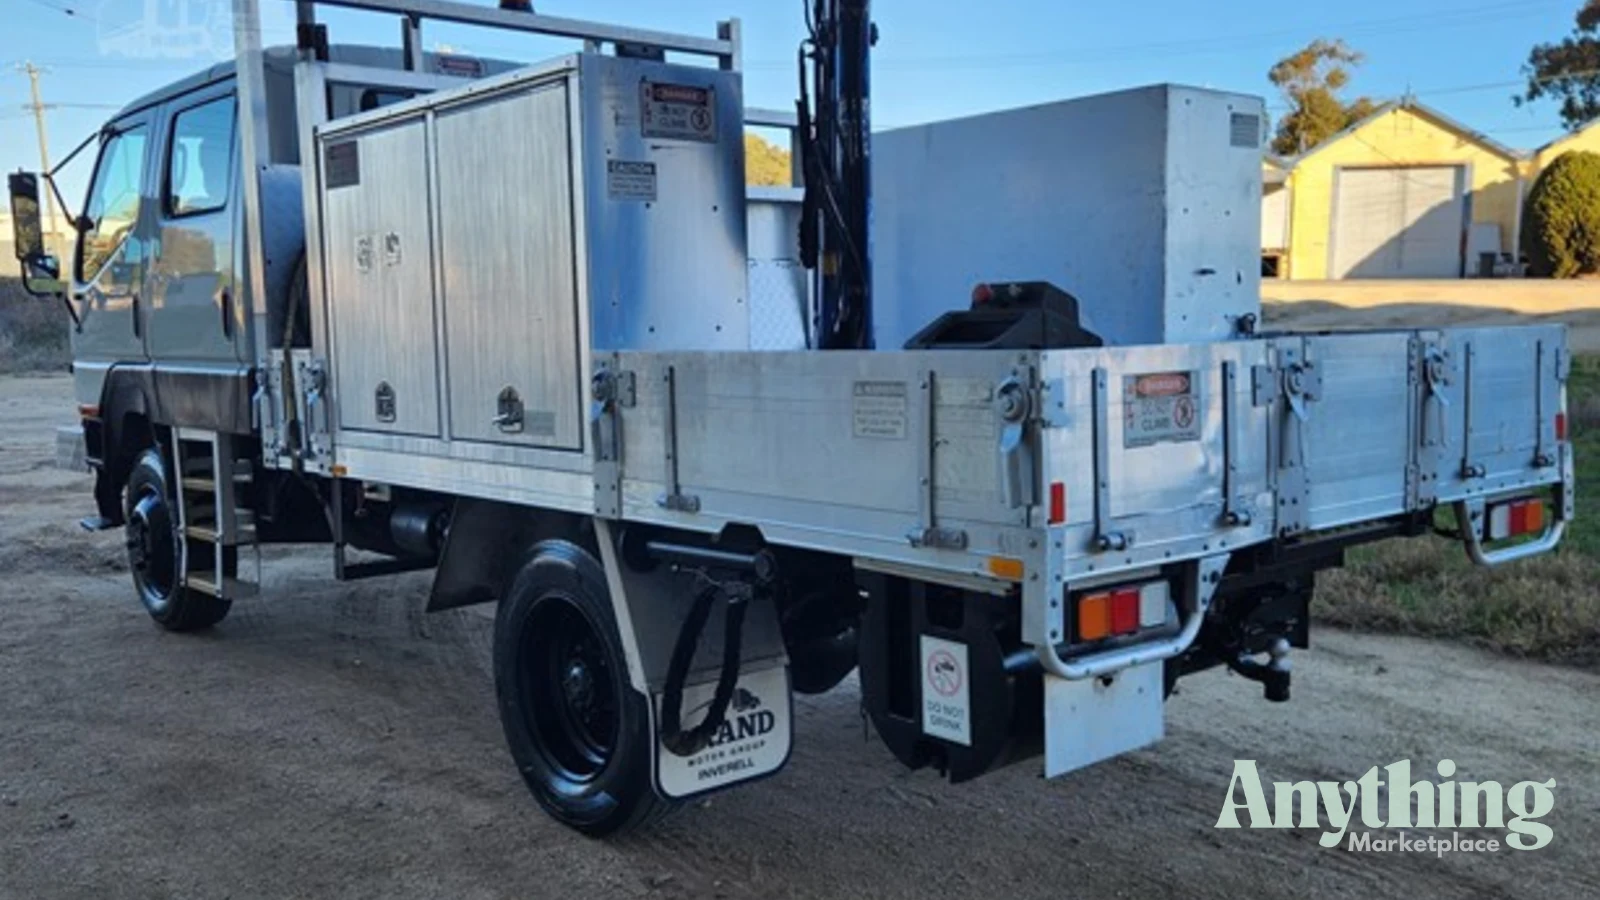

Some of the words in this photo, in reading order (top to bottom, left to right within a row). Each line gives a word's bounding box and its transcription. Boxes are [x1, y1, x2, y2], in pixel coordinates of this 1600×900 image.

[612, 162, 653, 174] CAUTION
[1141, 417, 1170, 431] CLIMB
[927, 701, 941, 713] DO
[943, 704, 965, 719] NOT
[708, 709, 775, 748] AND
[929, 714, 962, 732] DRINK
[688, 752, 725, 767] MOTOR
[730, 740, 765, 755] GROUP
[698, 757, 754, 780] INVERELL
